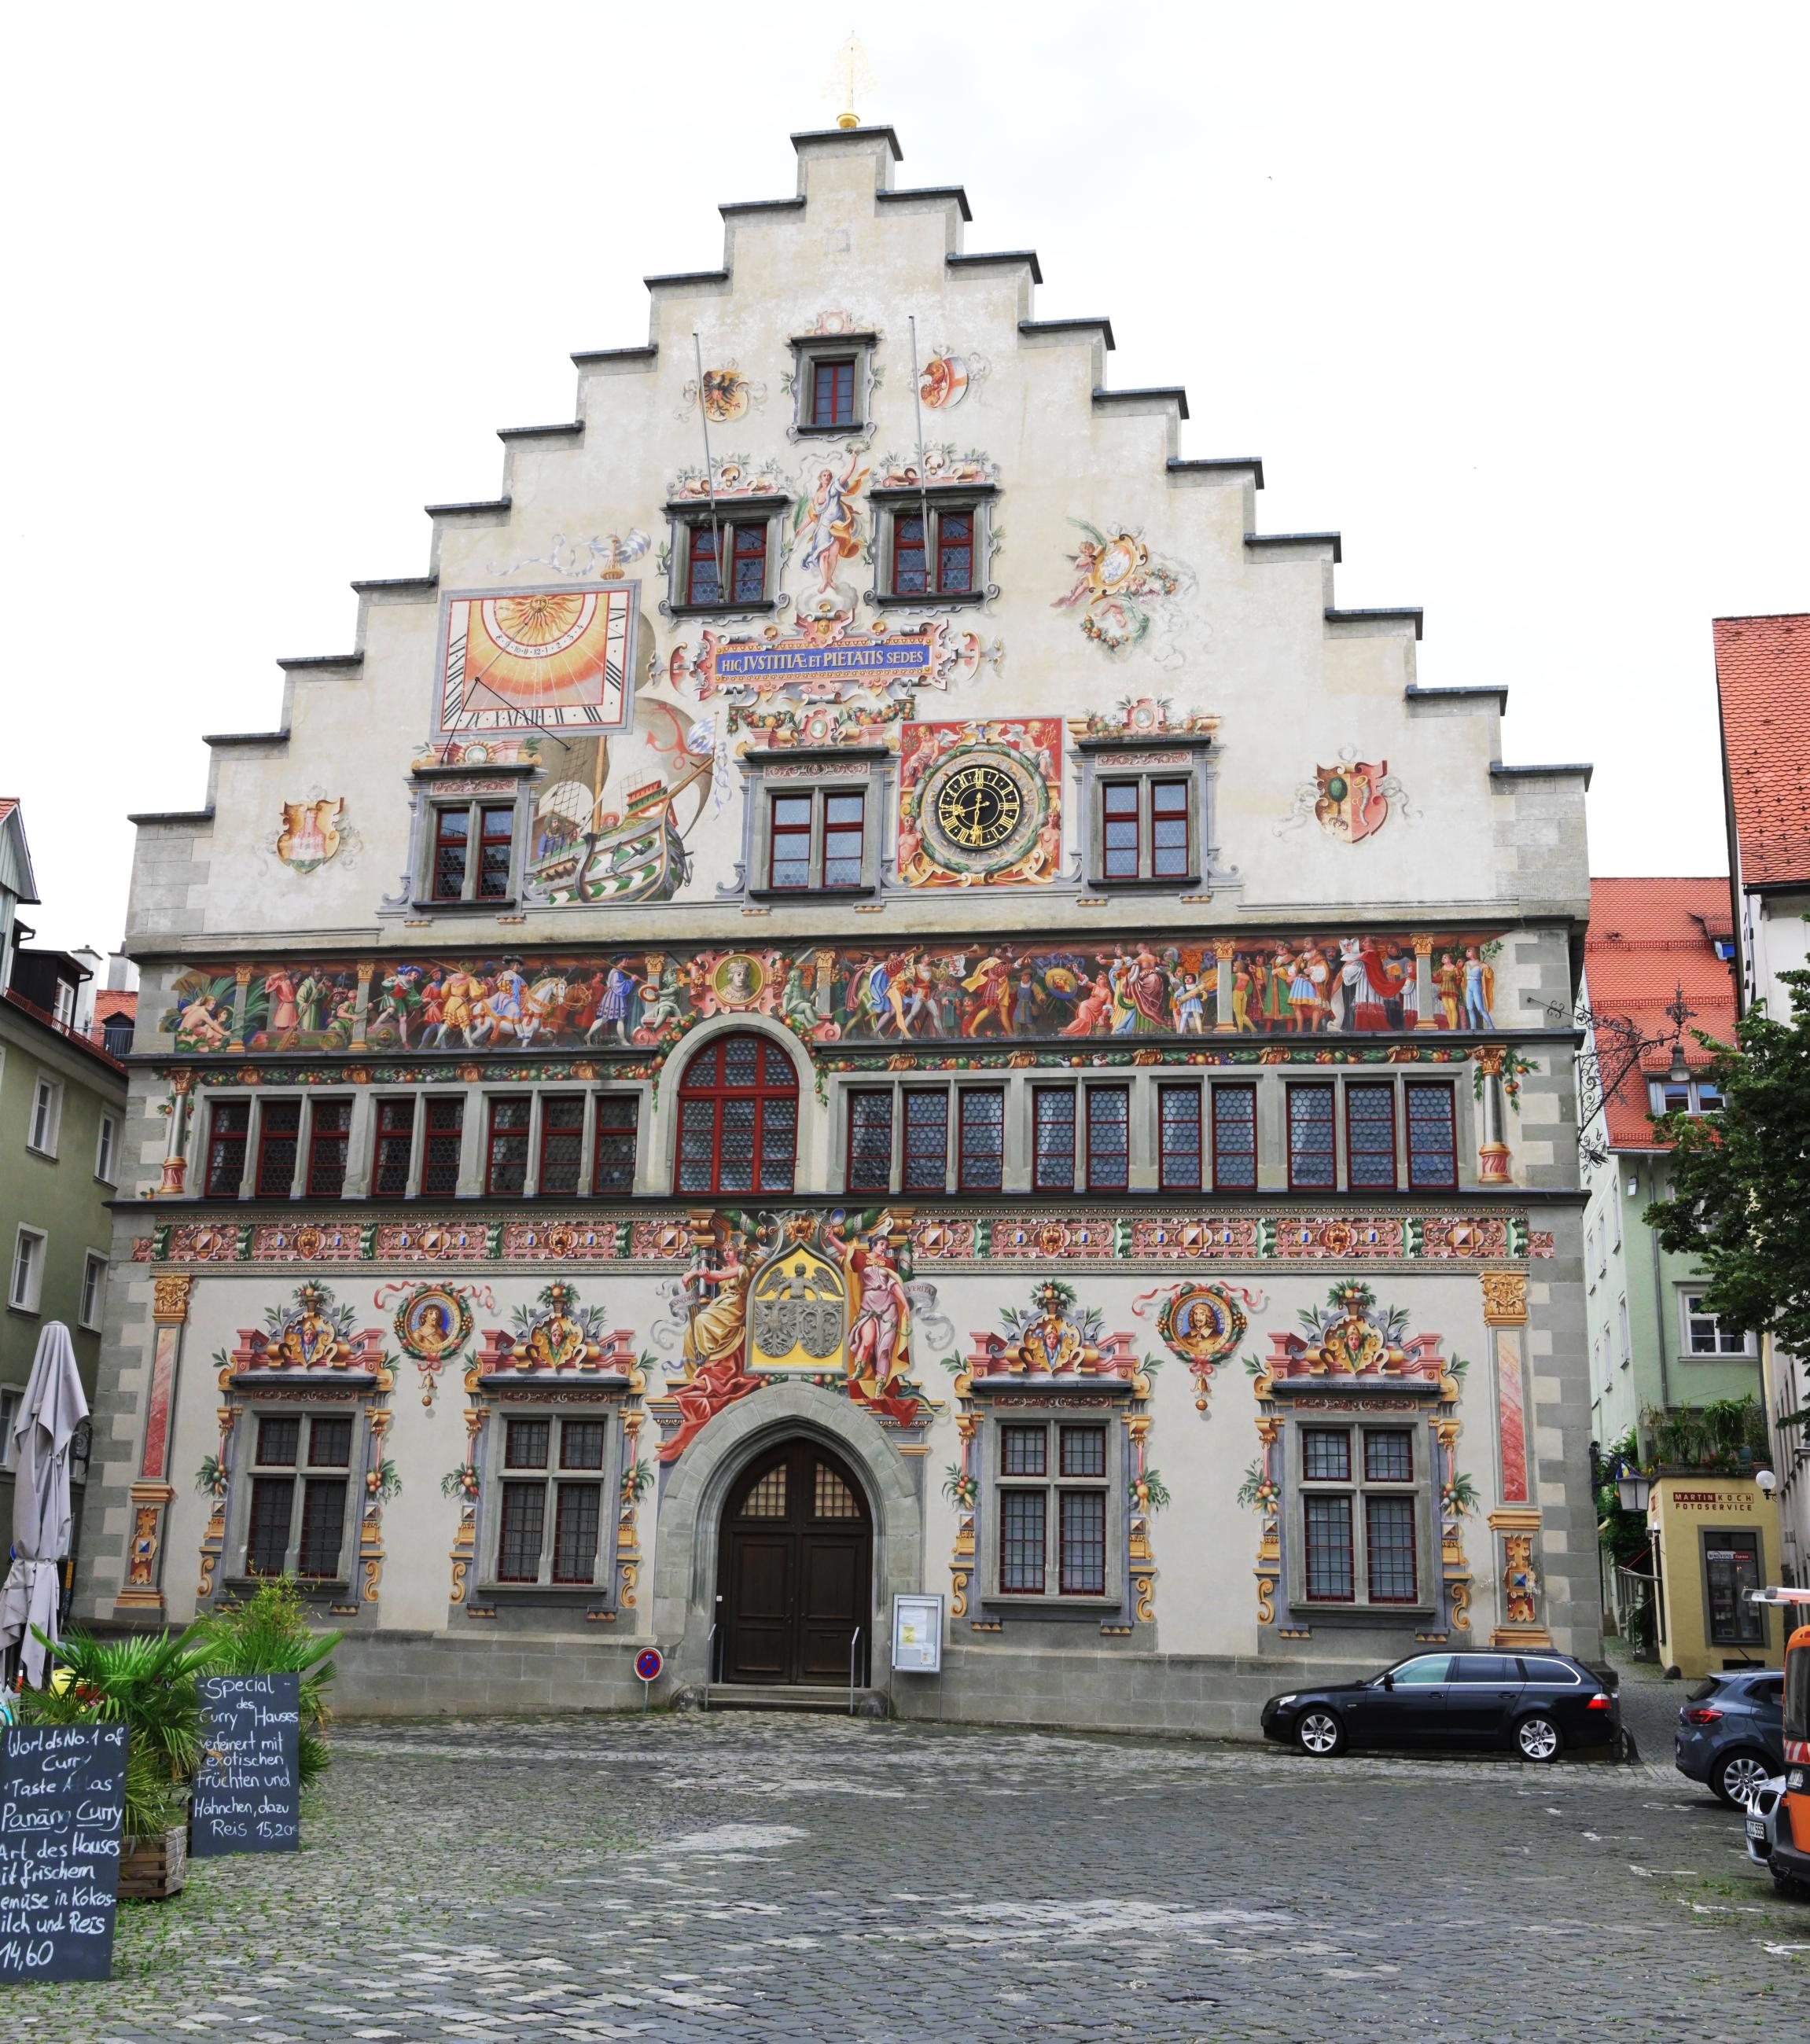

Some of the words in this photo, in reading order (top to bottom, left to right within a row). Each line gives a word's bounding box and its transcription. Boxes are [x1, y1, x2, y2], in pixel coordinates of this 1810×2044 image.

[722, 660, 742, 671] HIC
[809, 656, 821, 667] ET
[823, 651, 884, 667] PIETATIS
[886, 651, 924, 664] SEDES
[199, 1707, 237, 1730] Curry
[236, 1697, 256, 1709] des
[255, 1705, 299, 1727] Hauses
[105, 1726, 125, 1747] of
[199, 1730, 256, 1752] verfeinert
[261, 1731, 284, 1752] mit
[42, 1754, 93, 1772] Curry
[206, 1752, 284, 1767] exotischen
[196, 1766, 260, 1789] Früchten
[264, 1766, 291, 1787] und
[76, 1800, 123, 1833] Curry
[194, 1796, 256, 1818] Hähnchen,
[258, 1794, 289, 1814] dazu
[210, 1818, 248, 1837] Reis
[37, 1838, 68, 1858] des
[72, 1831, 120, 1857] Hauses
[0, 1862, 17, 1886] it
[20, 1859, 97, 1890] frischem
[0, 1893, 50, 1911] emüse
[54, 1889, 69, 1906] in
[0, 1911, 31, 1935] ilch
[36, 1911, 66, 1933] und
[69, 1910, 106, 1935] Reis
[0, 1939, 54, 1972] 14,60
